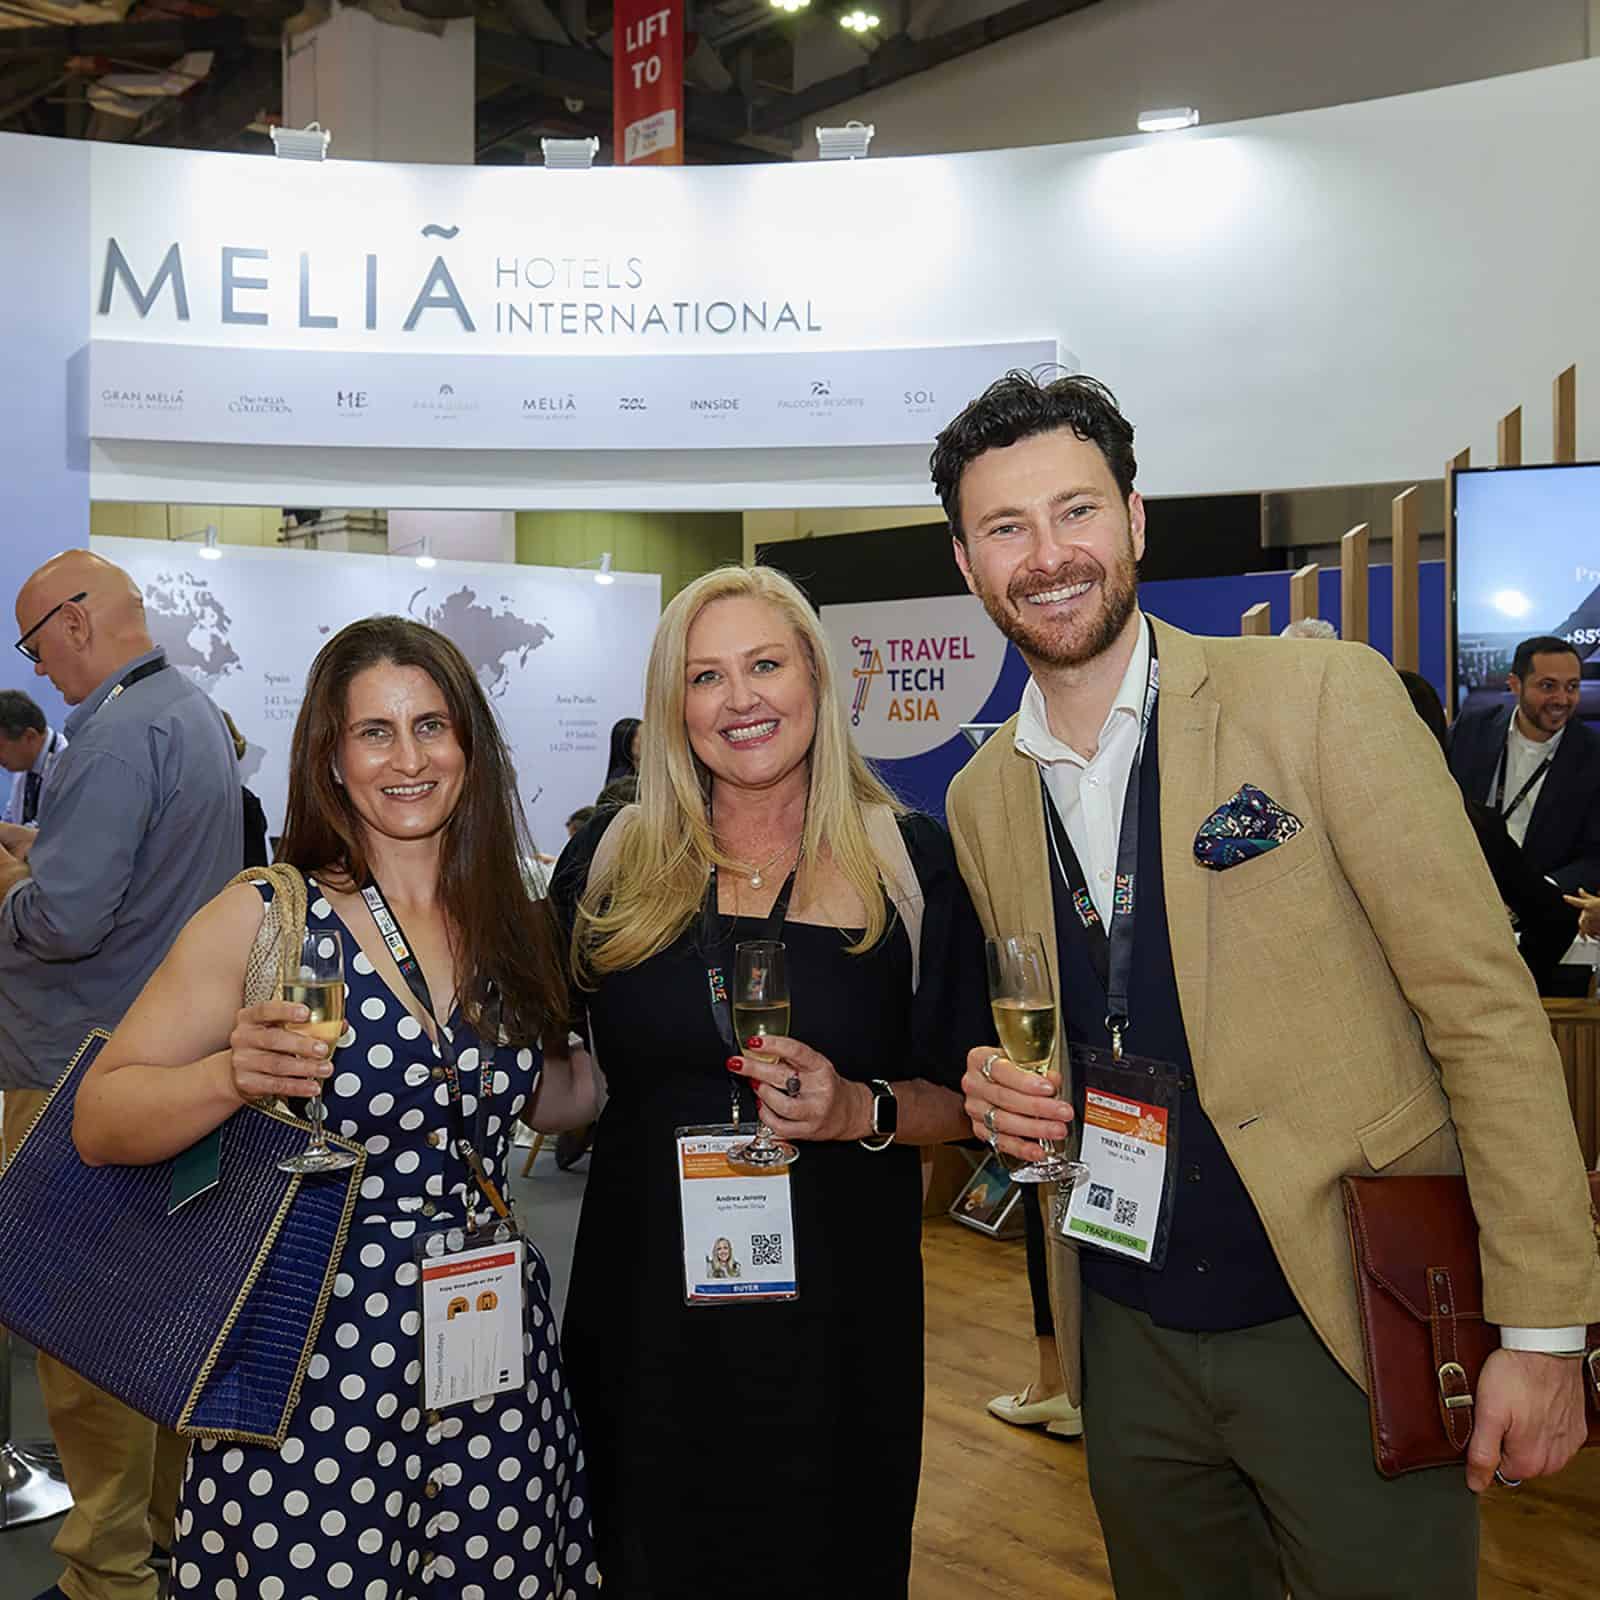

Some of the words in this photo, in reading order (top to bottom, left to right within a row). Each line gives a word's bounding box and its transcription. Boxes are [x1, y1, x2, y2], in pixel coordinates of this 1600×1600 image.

[625, 8, 671, 52] LIFT
[631, 55, 662, 89] TO
[496, 257, 644, 289] HOTELS
[496, 300, 823, 334] INTERNATIONAL
[102, 389, 141, 402] GRAN
[337, 391, 369, 409] ME
[903, 390, 936, 405] SOL
[887, 636, 976, 662] TRAVEL
[887, 668, 945, 691] TECH
[888, 697, 941, 721] ASIA
[1101, 1136, 1123, 1149] TRENT
[733, 1284, 760, 1293] BUYER
